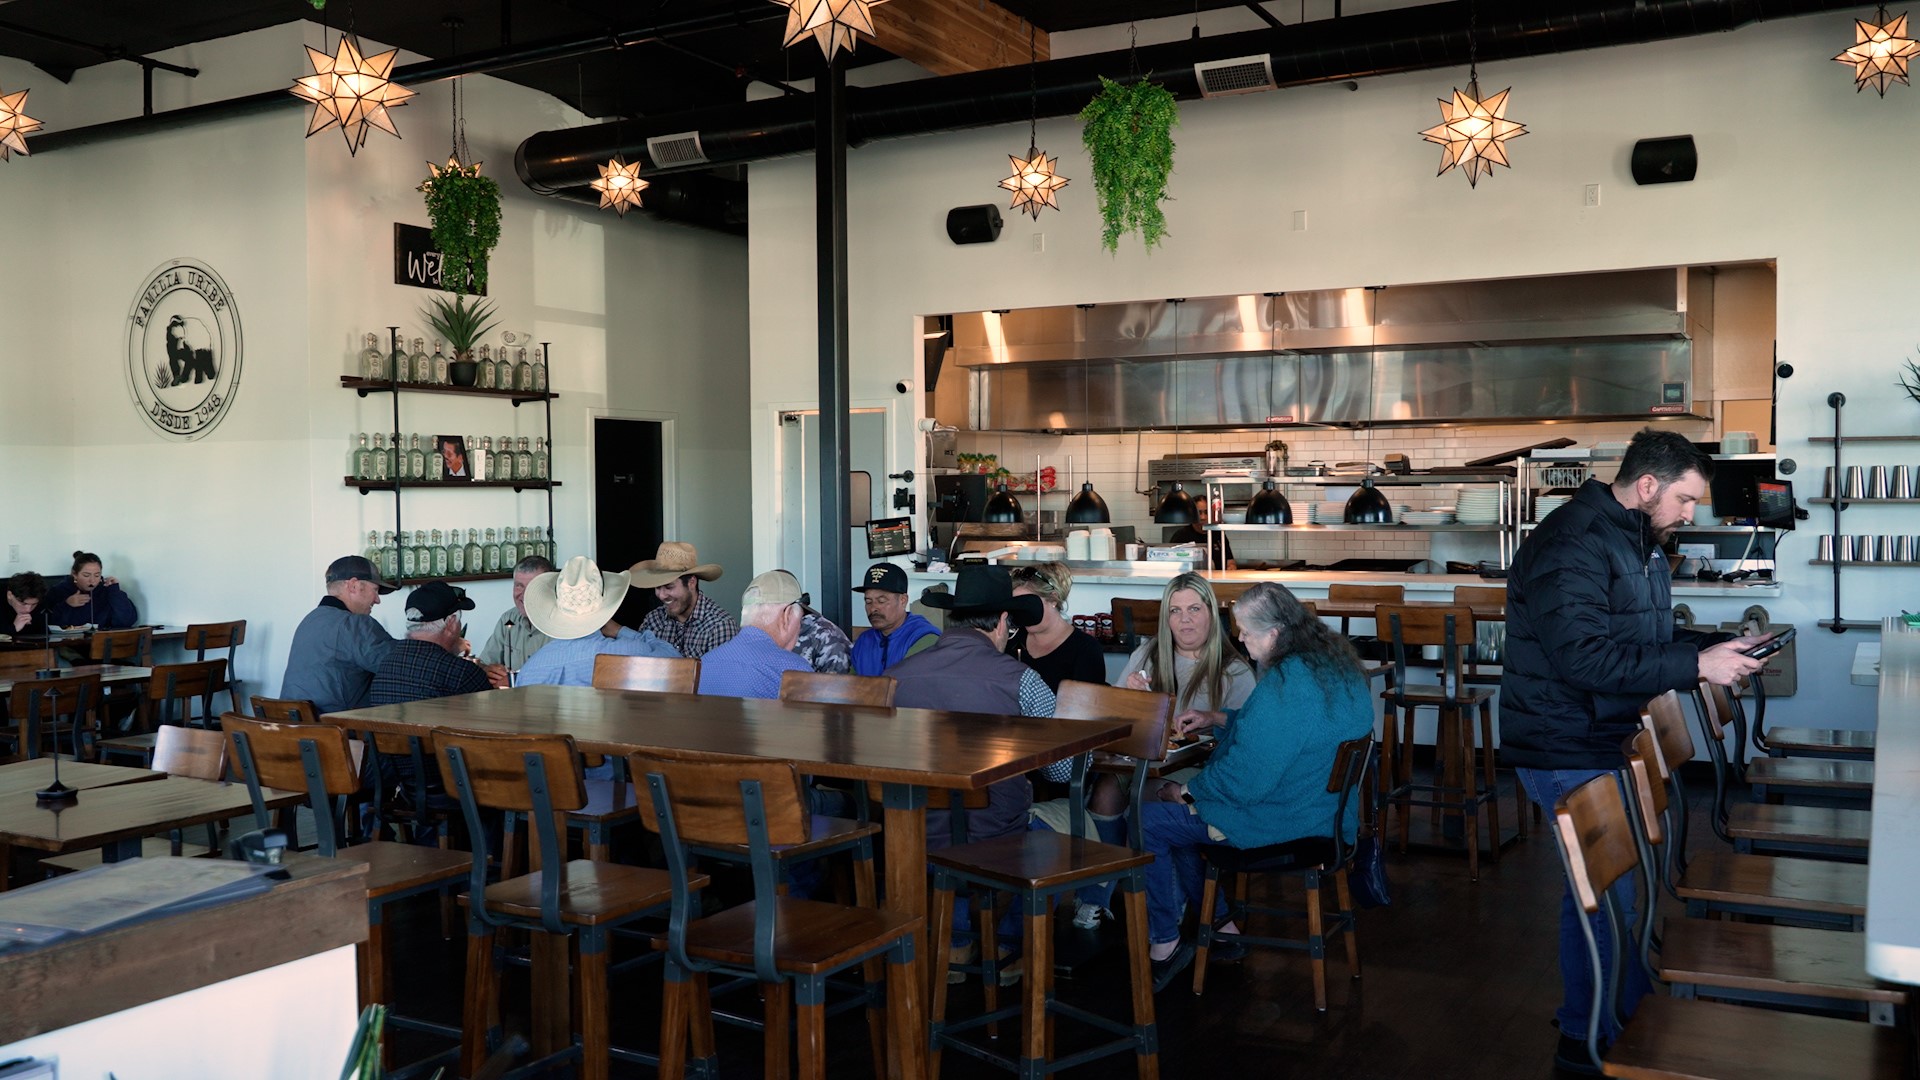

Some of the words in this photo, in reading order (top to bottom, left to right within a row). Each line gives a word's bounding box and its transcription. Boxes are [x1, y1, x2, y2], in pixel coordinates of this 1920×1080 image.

[135, 271, 181, 329] FAMILIA
[188, 271, 225, 312] URIBE
[151, 401, 190, 430] DESDE
[195, 393, 221, 426] 1948
